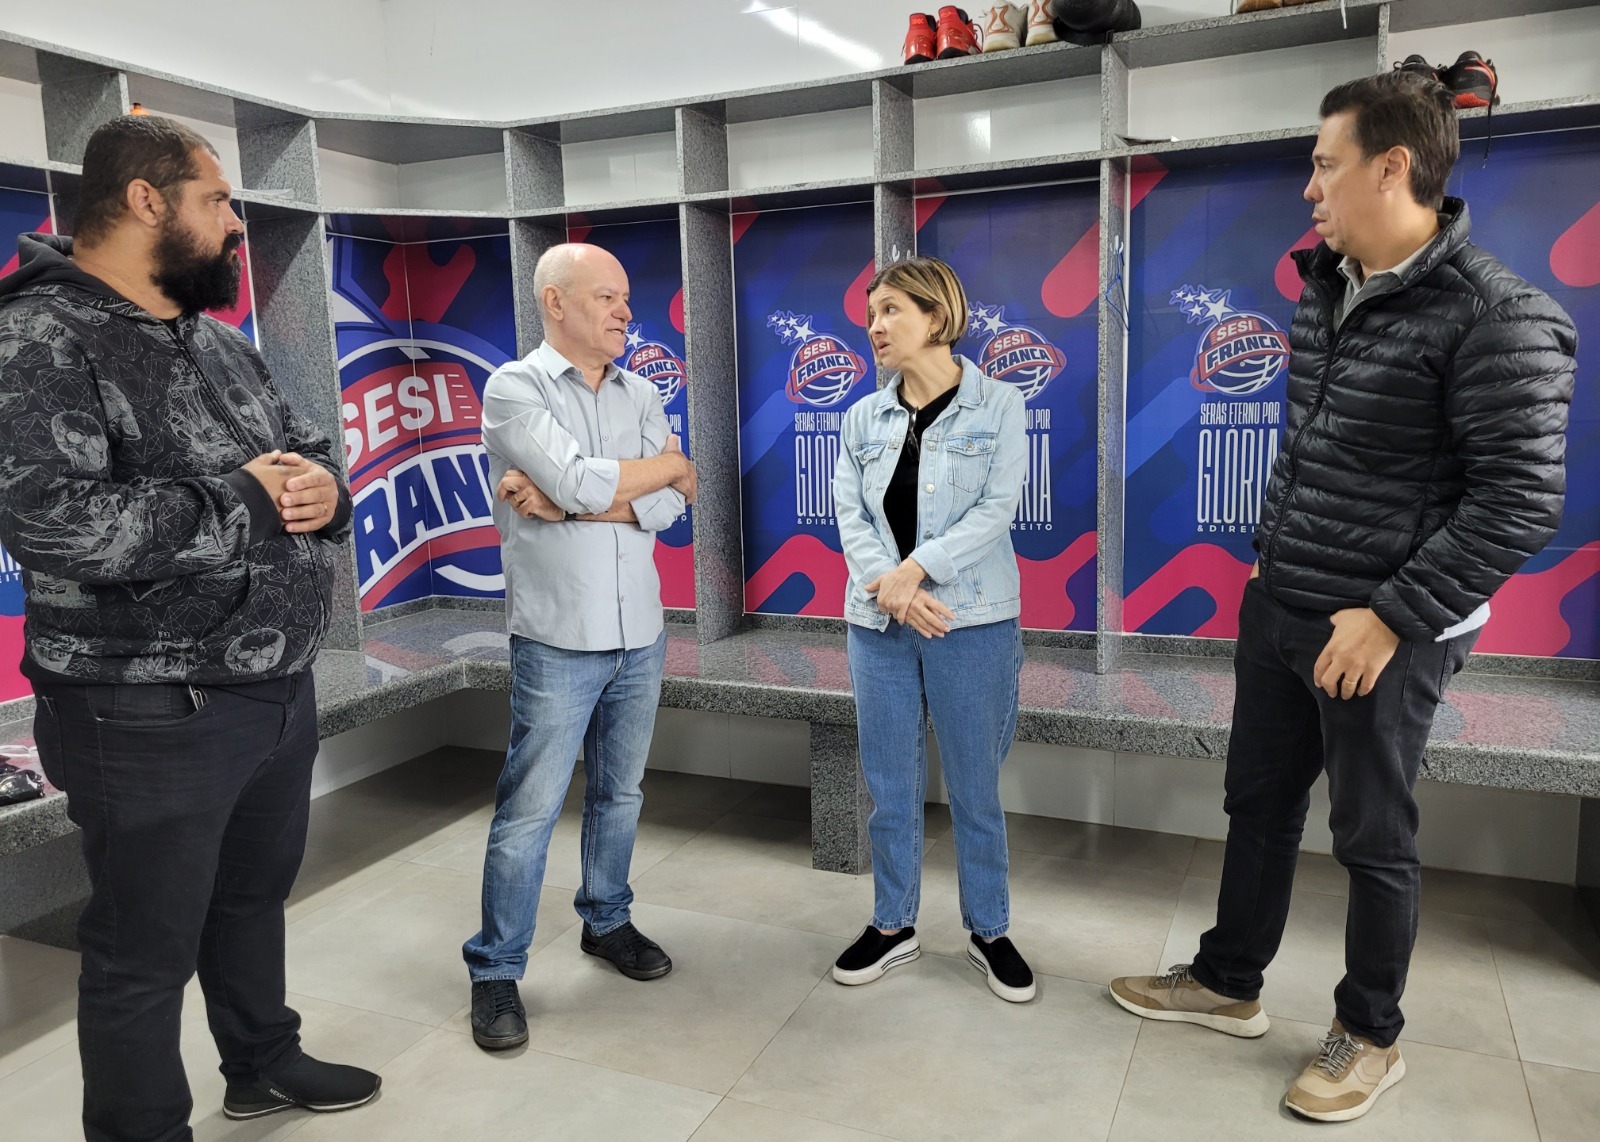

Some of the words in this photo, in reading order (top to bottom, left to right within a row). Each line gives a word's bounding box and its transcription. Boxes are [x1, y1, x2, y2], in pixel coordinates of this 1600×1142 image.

[1216, 320, 1253, 342] SESI
[803, 341, 831, 360] SESI
[993, 334, 1025, 354] SESI
[1205, 335, 1284, 372] FRANCA
[635, 348, 659, 366] SESI
[986, 348, 1053, 378] FRANCA
[639, 360, 680, 379] RANCA
[797, 355, 854, 385] FRANCA
[342, 373, 454, 470] SESI
[794, 410, 815, 432] SERÁS
[816, 411, 840, 432] ETERNO
[1035, 408, 1051, 430] POR
[1200, 400, 1227, 425] SERÁS
[1228, 402, 1260, 425] ETERNO
[1262, 401, 1280, 424] POR
[795, 431, 840, 517] GLÓR
[353, 453, 492, 576] RAN
[797, 517, 803, 525] &
[806, 518, 835, 526] DIRE
[1010, 523, 1053, 531] REITO
[1197, 524, 1204, 533] &
[1209, 524, 1255, 534] DIREI
